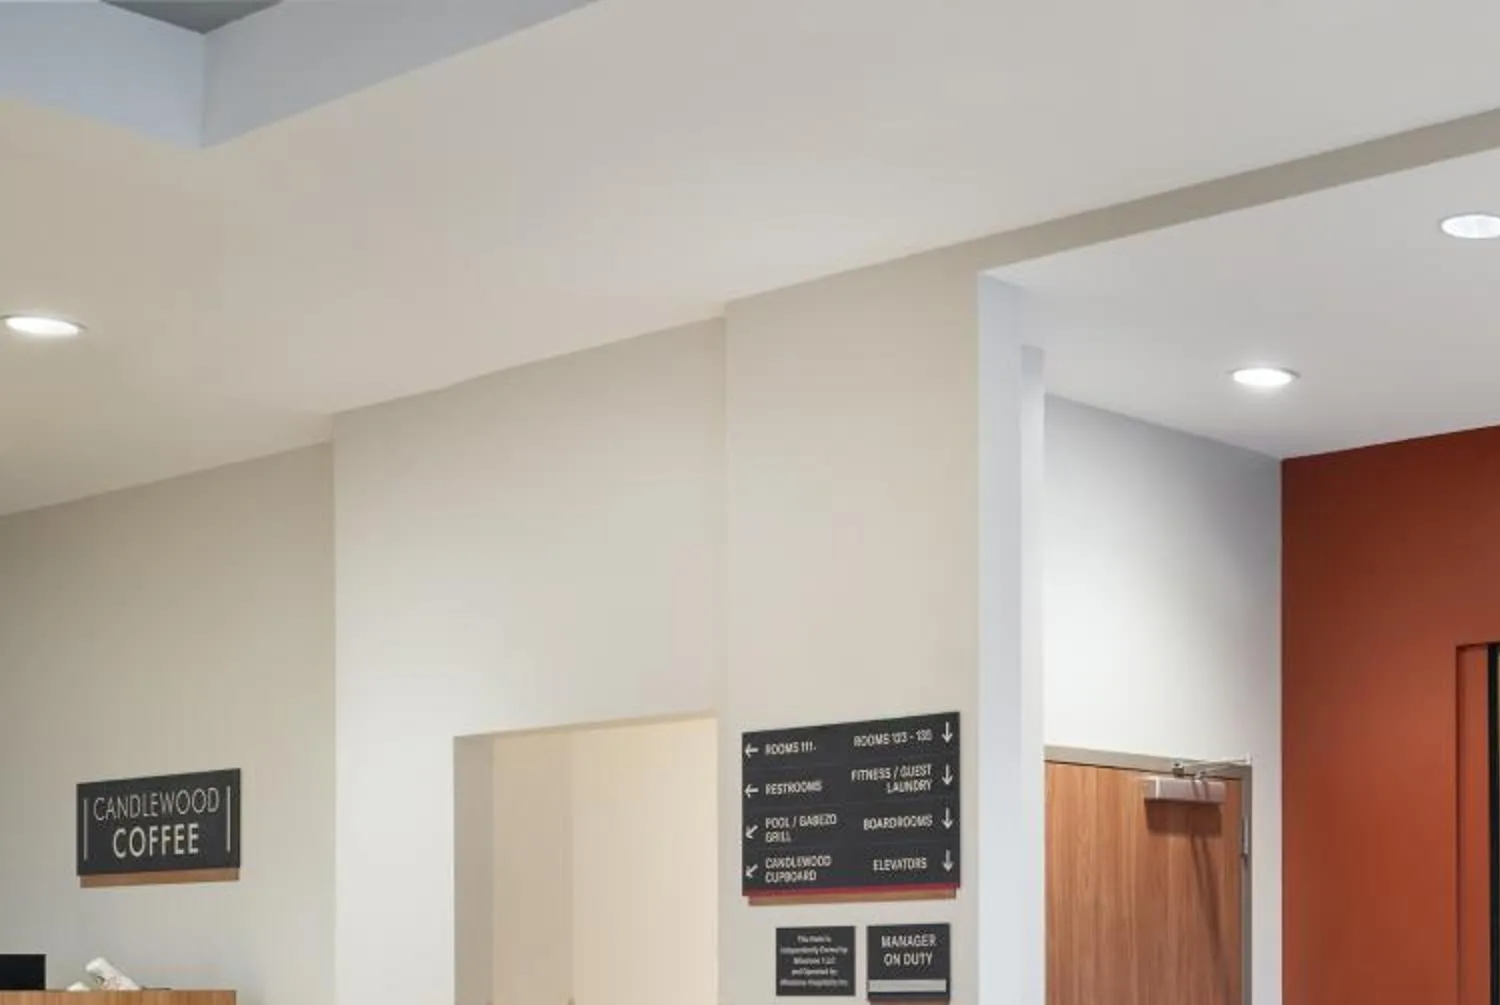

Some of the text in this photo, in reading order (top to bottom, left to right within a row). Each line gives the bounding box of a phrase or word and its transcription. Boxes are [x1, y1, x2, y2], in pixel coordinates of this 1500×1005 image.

[854, 733, 890, 746] ROOMS
[765, 742, 799, 755] ROOMS
[851, 768, 891, 782] FITNESS
[900, 763, 932, 777] GUEST
[766, 780, 822, 795] RESTROOMS
[887, 779, 932, 794] LAUNDRY
[94, 787, 219, 821] CANDLEWOOD
[765, 817, 790, 829] POOL
[864, 814, 932, 830] BOARDROOMS
[113, 823, 199, 858] COFFEE
[765, 831, 791, 843] GRILL
[765, 855, 832, 869] CANDLEWOOD
[873, 857, 927, 871] ELEVATORS
[765, 868, 816, 883] CUPBOARD
[882, 934, 936, 948] MANAGER
[884, 952, 932, 966] ON DUTY
